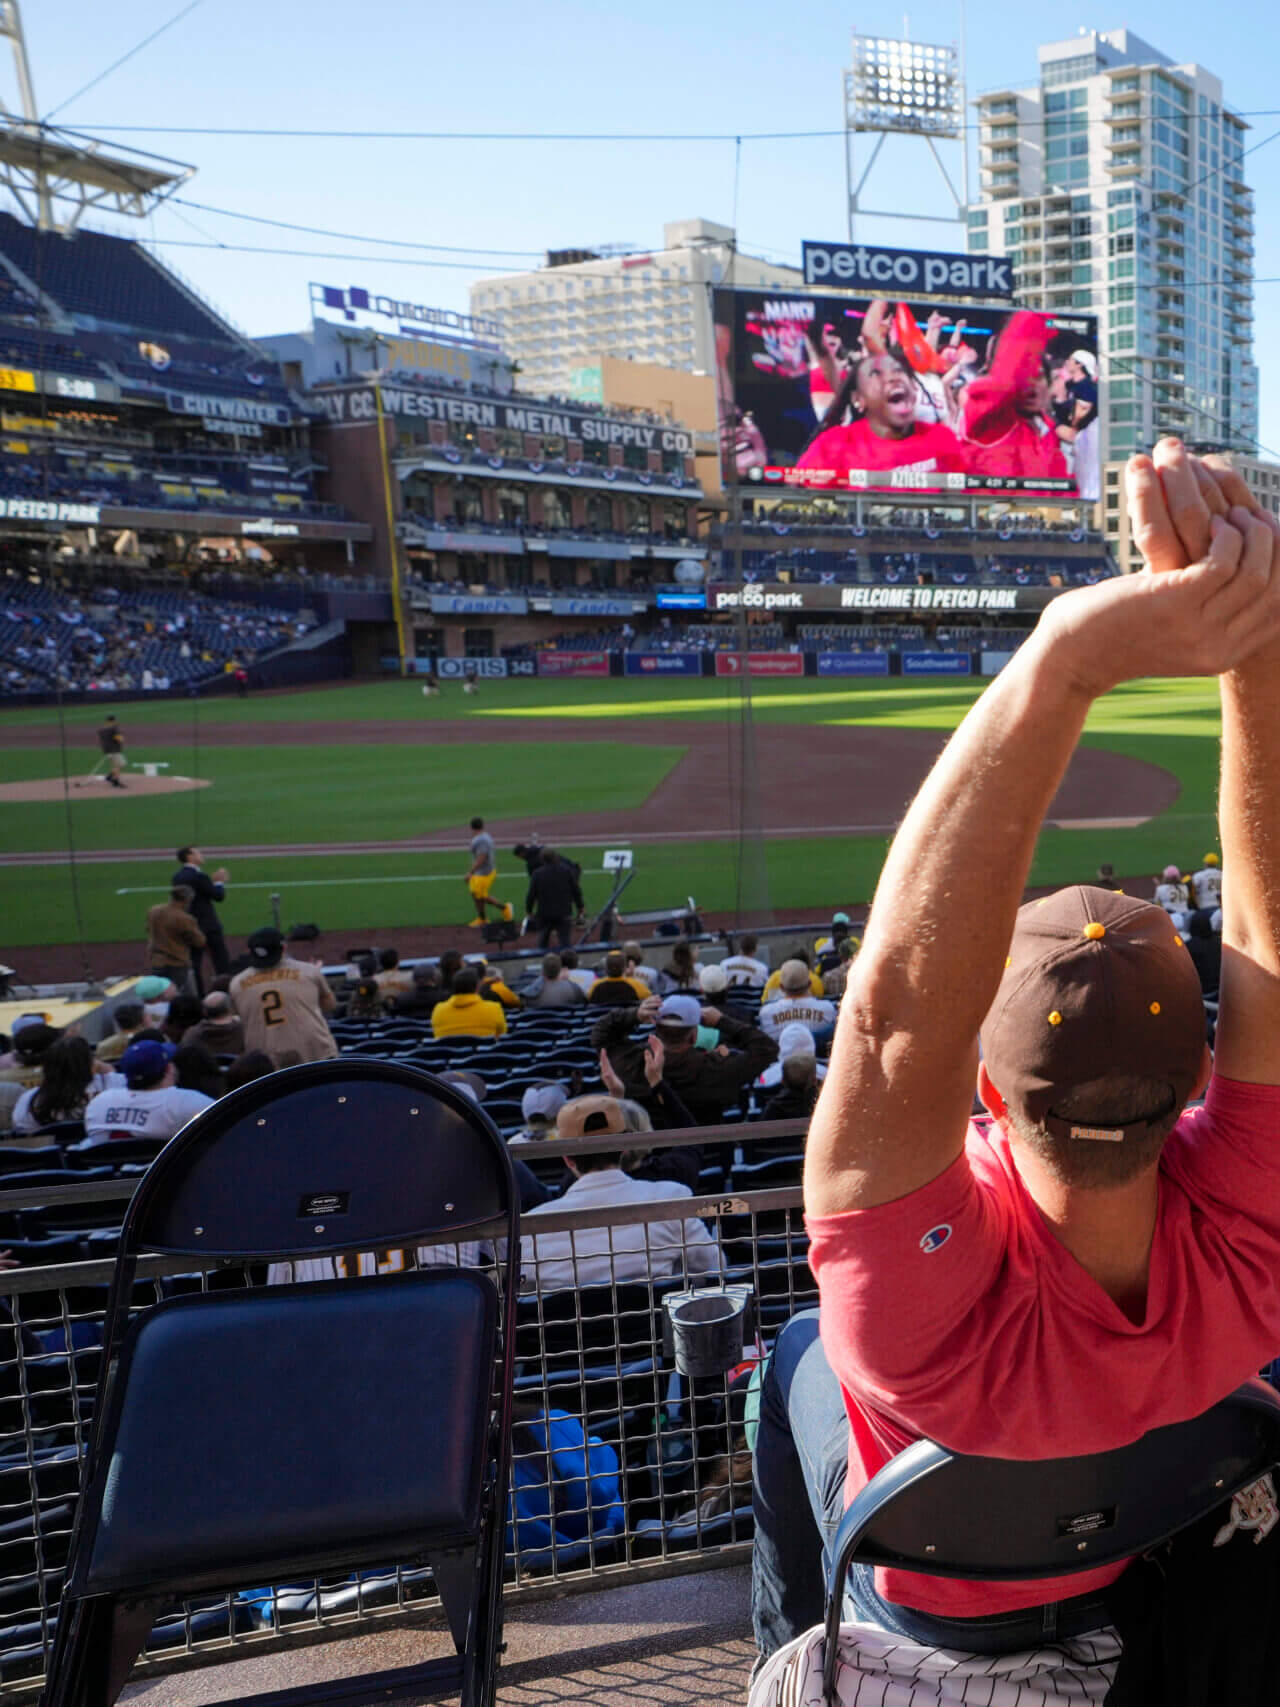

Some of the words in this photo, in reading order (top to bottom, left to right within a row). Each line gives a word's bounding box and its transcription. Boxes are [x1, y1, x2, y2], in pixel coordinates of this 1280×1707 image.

[805, 249, 919, 283] petco
[924, 258, 1010, 292] park
[183, 395, 278, 423] CUTWATER
[381, 389, 496, 426] WESTERN
[505, 411, 577, 438] METAL
[581, 419, 656, 448] SUPPLY
[662, 432, 694, 453] CO.
[7, 500, 56, 518] PETCO
[58, 504, 100, 522] PARK
[716, 591, 765, 610] petco
[765, 591, 803, 609] park
[841, 588, 912, 608] WELCOME
[914, 589, 935, 607] TO
[935, 590, 979, 608] PETCO
[980, 590, 1017, 609] PARK
[440, 659, 503, 677] ORIS
[511, 661, 534, 674] 342
[656, 656, 685, 669] bank
[906, 657, 959, 669] Southwest
[261, 990, 287, 1027] 2
[105, 1107, 150, 1126] BETTS
[713, 1200, 733, 1214] 12
